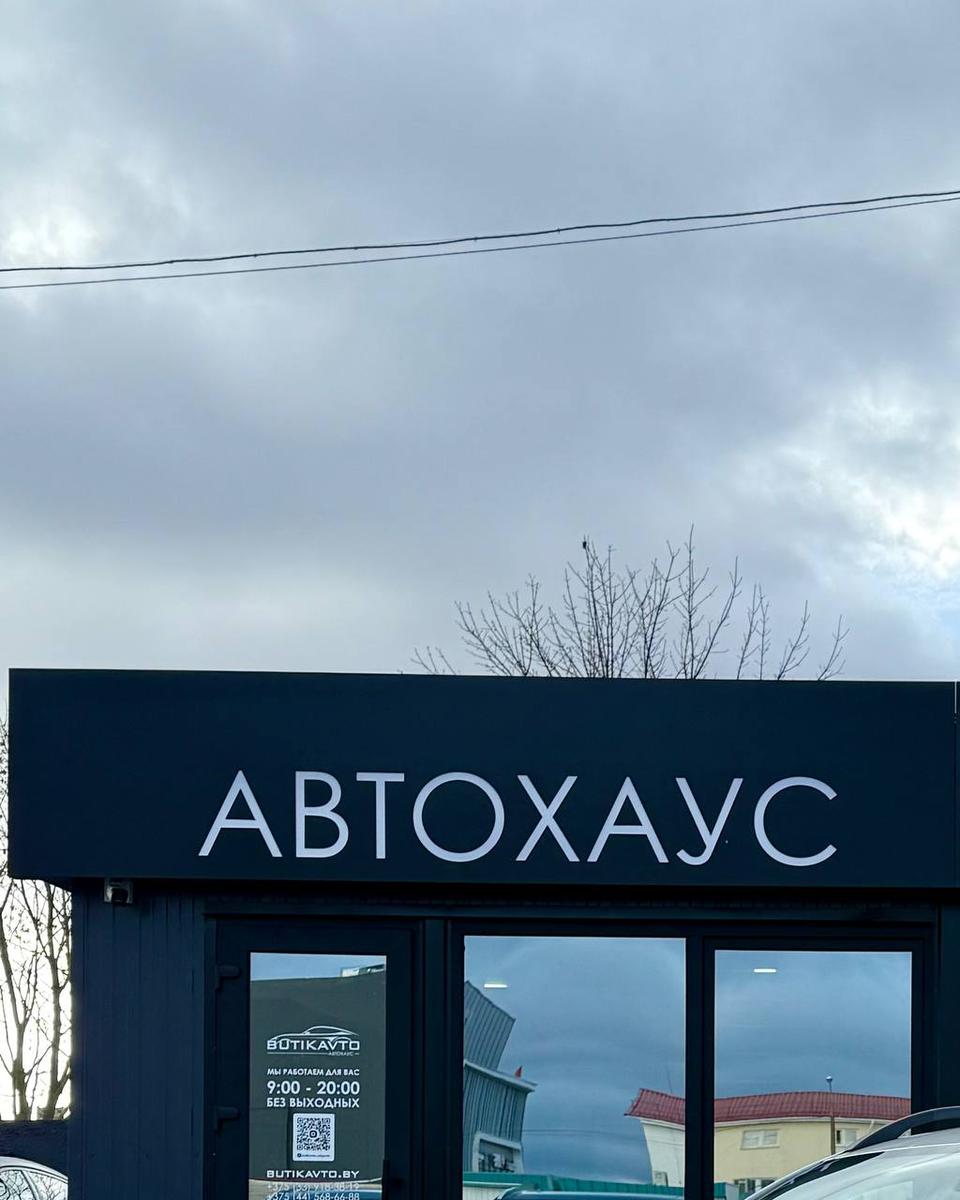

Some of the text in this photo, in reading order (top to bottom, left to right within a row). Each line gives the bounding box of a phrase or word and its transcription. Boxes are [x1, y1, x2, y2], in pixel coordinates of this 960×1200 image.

[198, 770, 838, 867] АВТОХАУС
[266, 1039, 360, 1051] BUTIKAVTO
[267, 1068, 281, 1076] МЫ
[282, 1068, 324, 1076] РАБОТАЕМ
[266, 1080, 301, 1095] 9:00
[316, 1080, 360, 1095] 20:00
[266, 1097, 360, 1109] БЕЗ ВЫХОДНЫХ
[266, 1170, 360, 1179] BUTIKAVTO.BY
